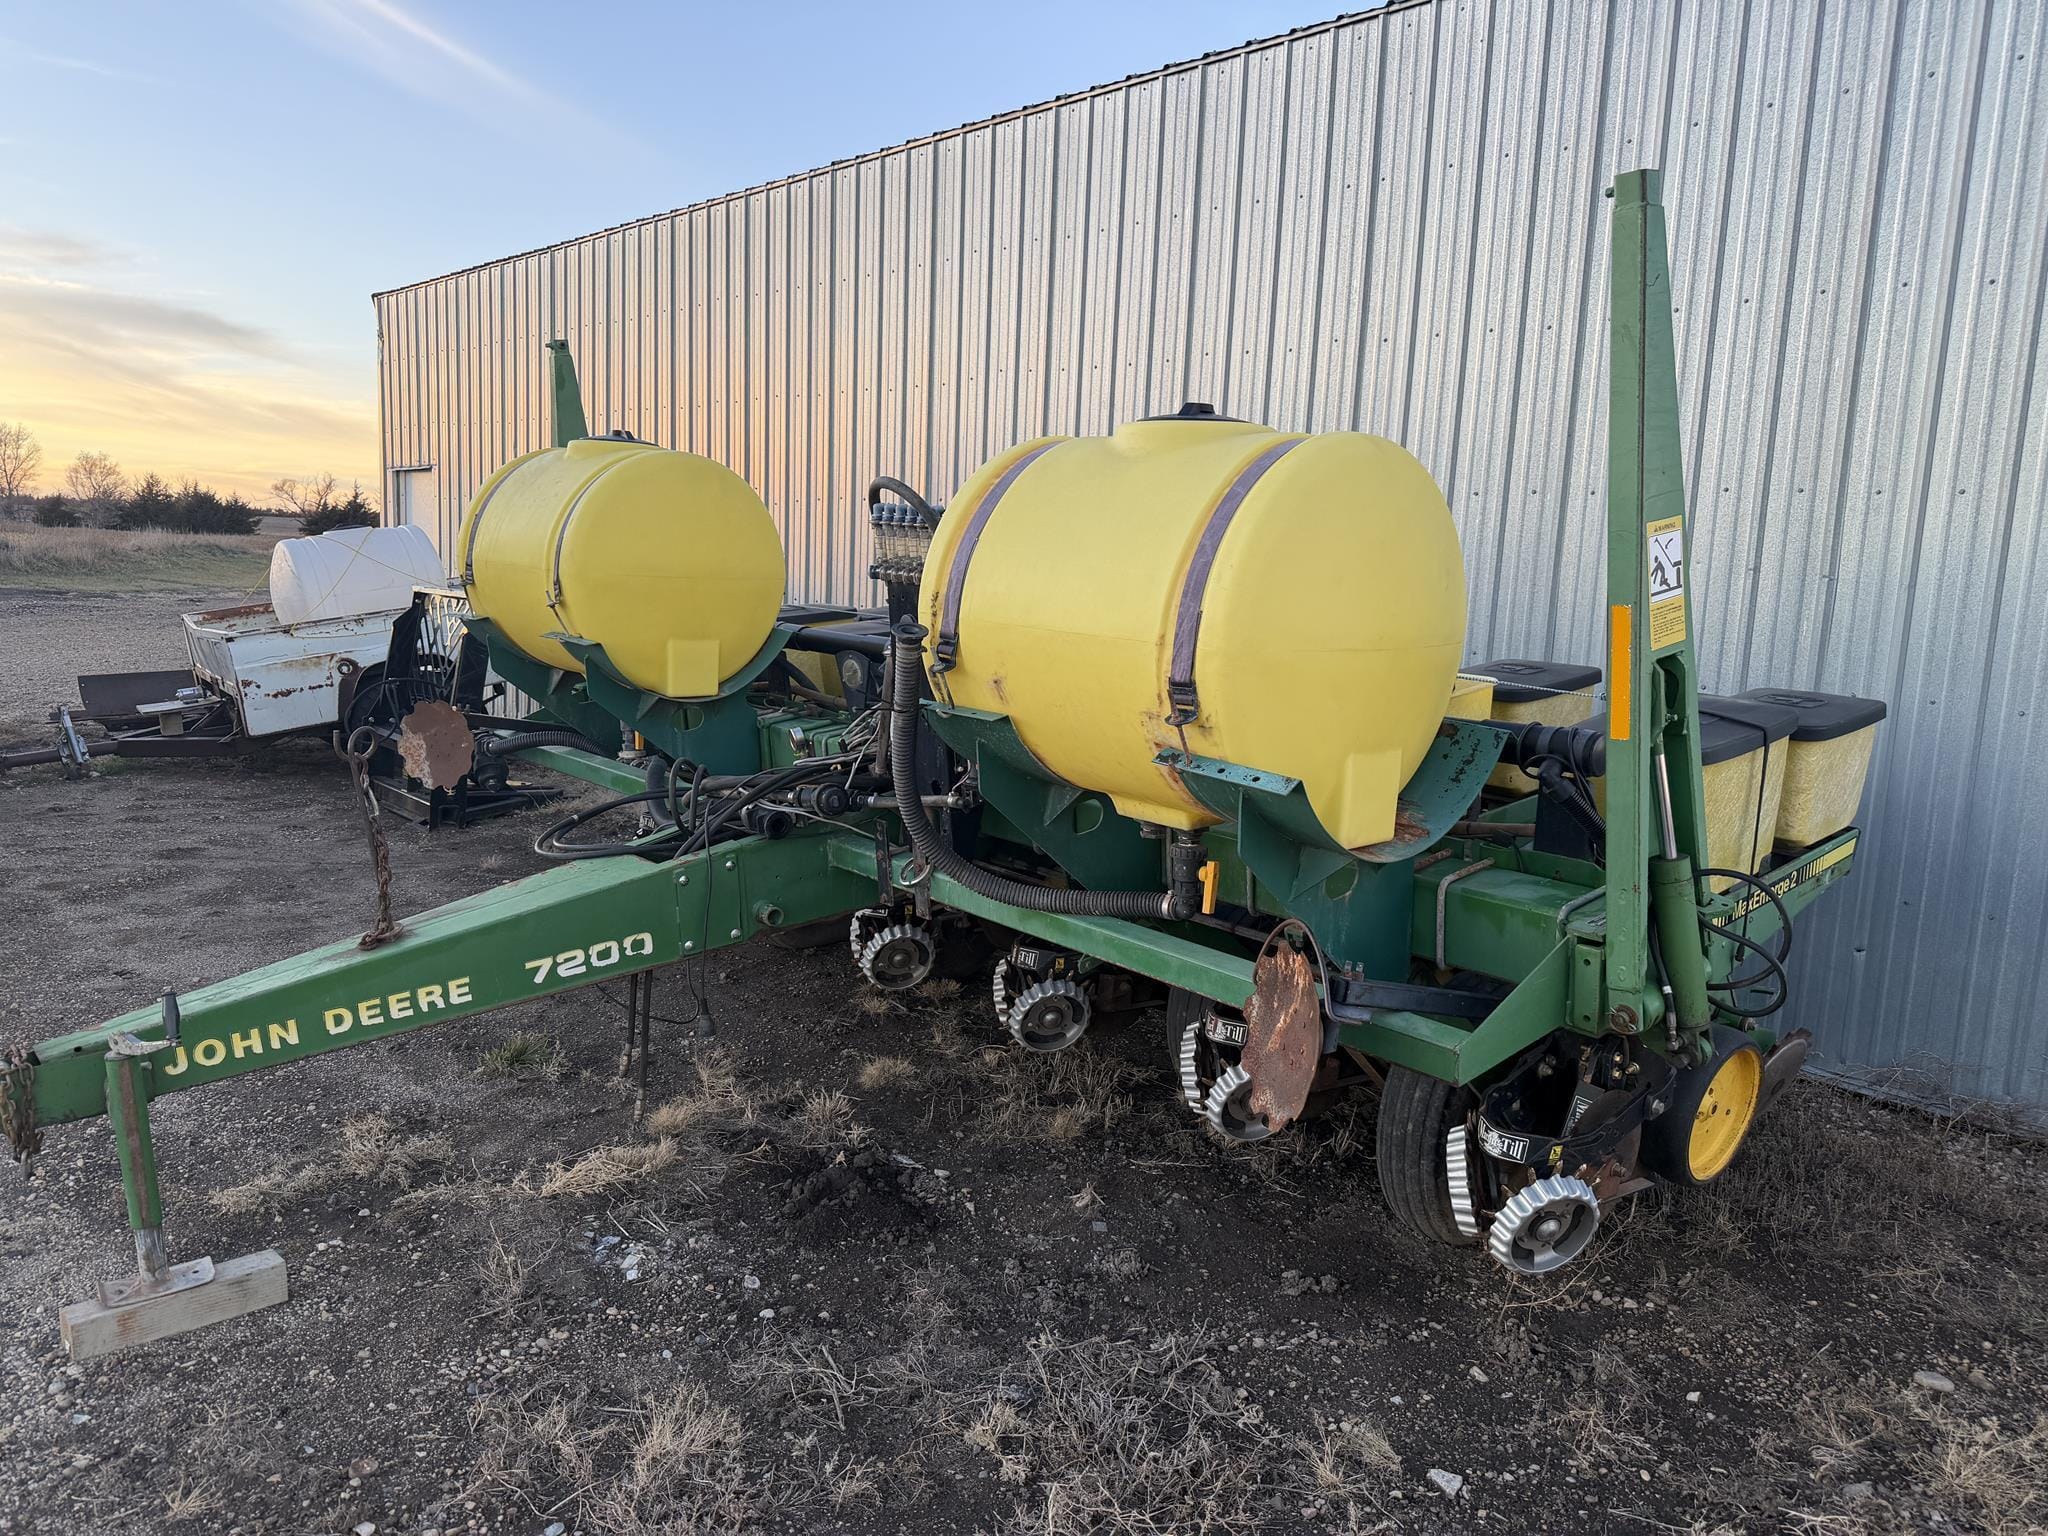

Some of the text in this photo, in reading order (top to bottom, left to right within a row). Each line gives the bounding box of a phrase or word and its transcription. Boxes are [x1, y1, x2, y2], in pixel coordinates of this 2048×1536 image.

[1732, 870, 1798, 920] MaxEmrge 2
[164, 931, 653, 1076] JOHN DEERE 7200
[1225, 1024, 1244, 1042] Till
